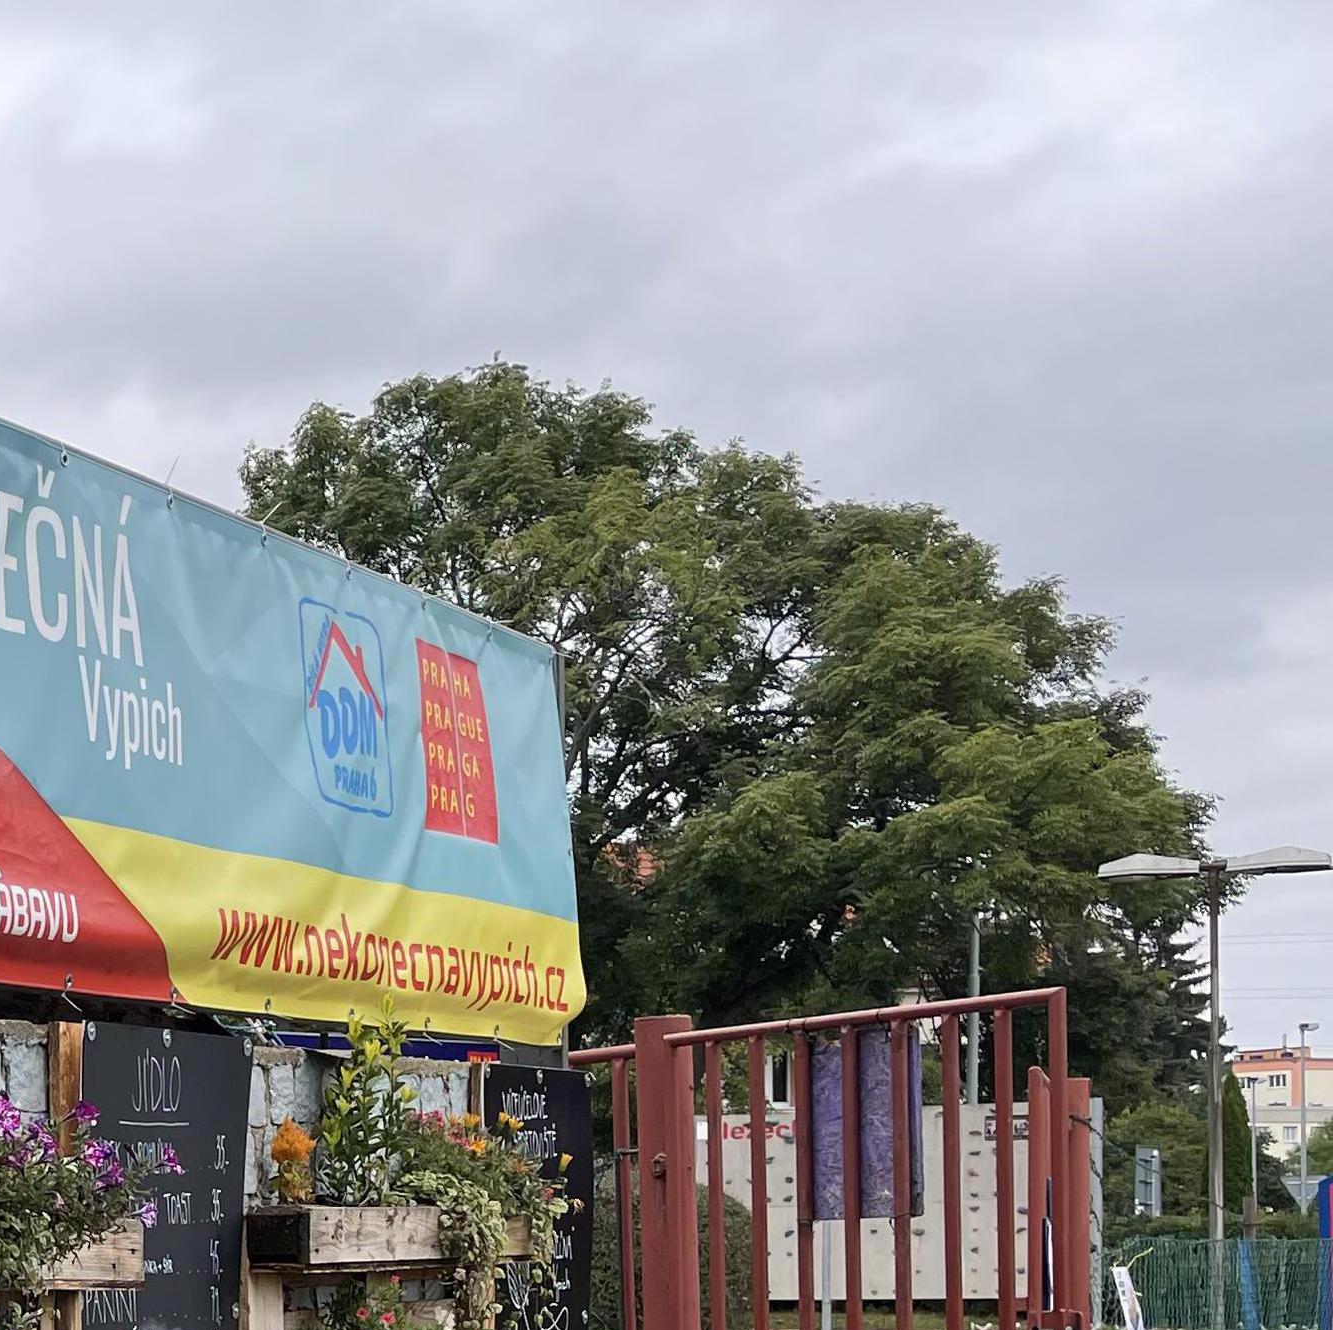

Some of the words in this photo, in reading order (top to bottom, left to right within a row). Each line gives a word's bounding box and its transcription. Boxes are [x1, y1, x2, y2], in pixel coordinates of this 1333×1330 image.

[78, 655, 184, 769] Vypich
[209, 907, 569, 1012] www.nekonecnavypich.cz
[131, 1048, 182, 1113] JÍDLO
